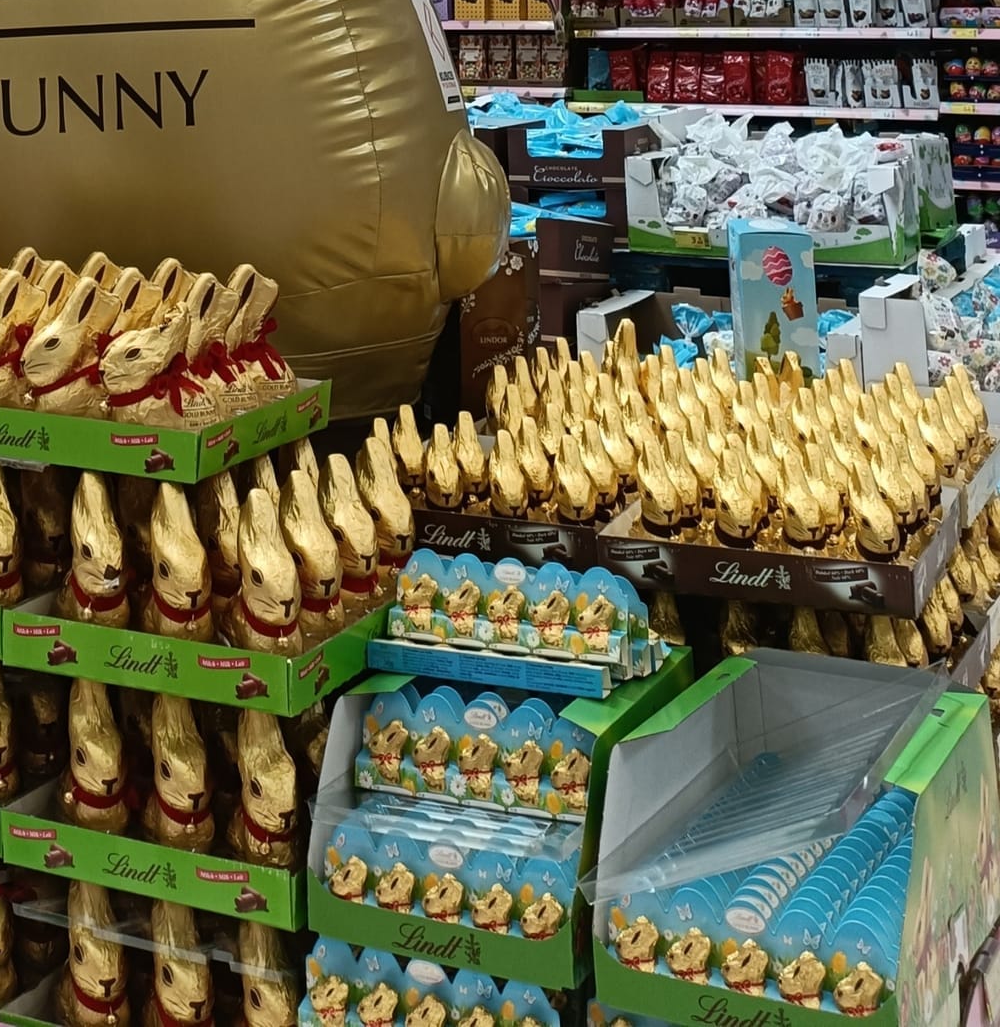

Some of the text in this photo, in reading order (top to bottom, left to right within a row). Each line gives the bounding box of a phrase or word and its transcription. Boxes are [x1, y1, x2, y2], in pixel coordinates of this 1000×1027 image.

[479, 335, 508, 344] LINDOR
[418, 524, 476, 550] Lindt
[709, 561, 774, 588] Lindt
[104, 644, 164, 676] Lindt
[102, 852, 164, 886] Lindt
[391, 921, 464, 962] Lindt
